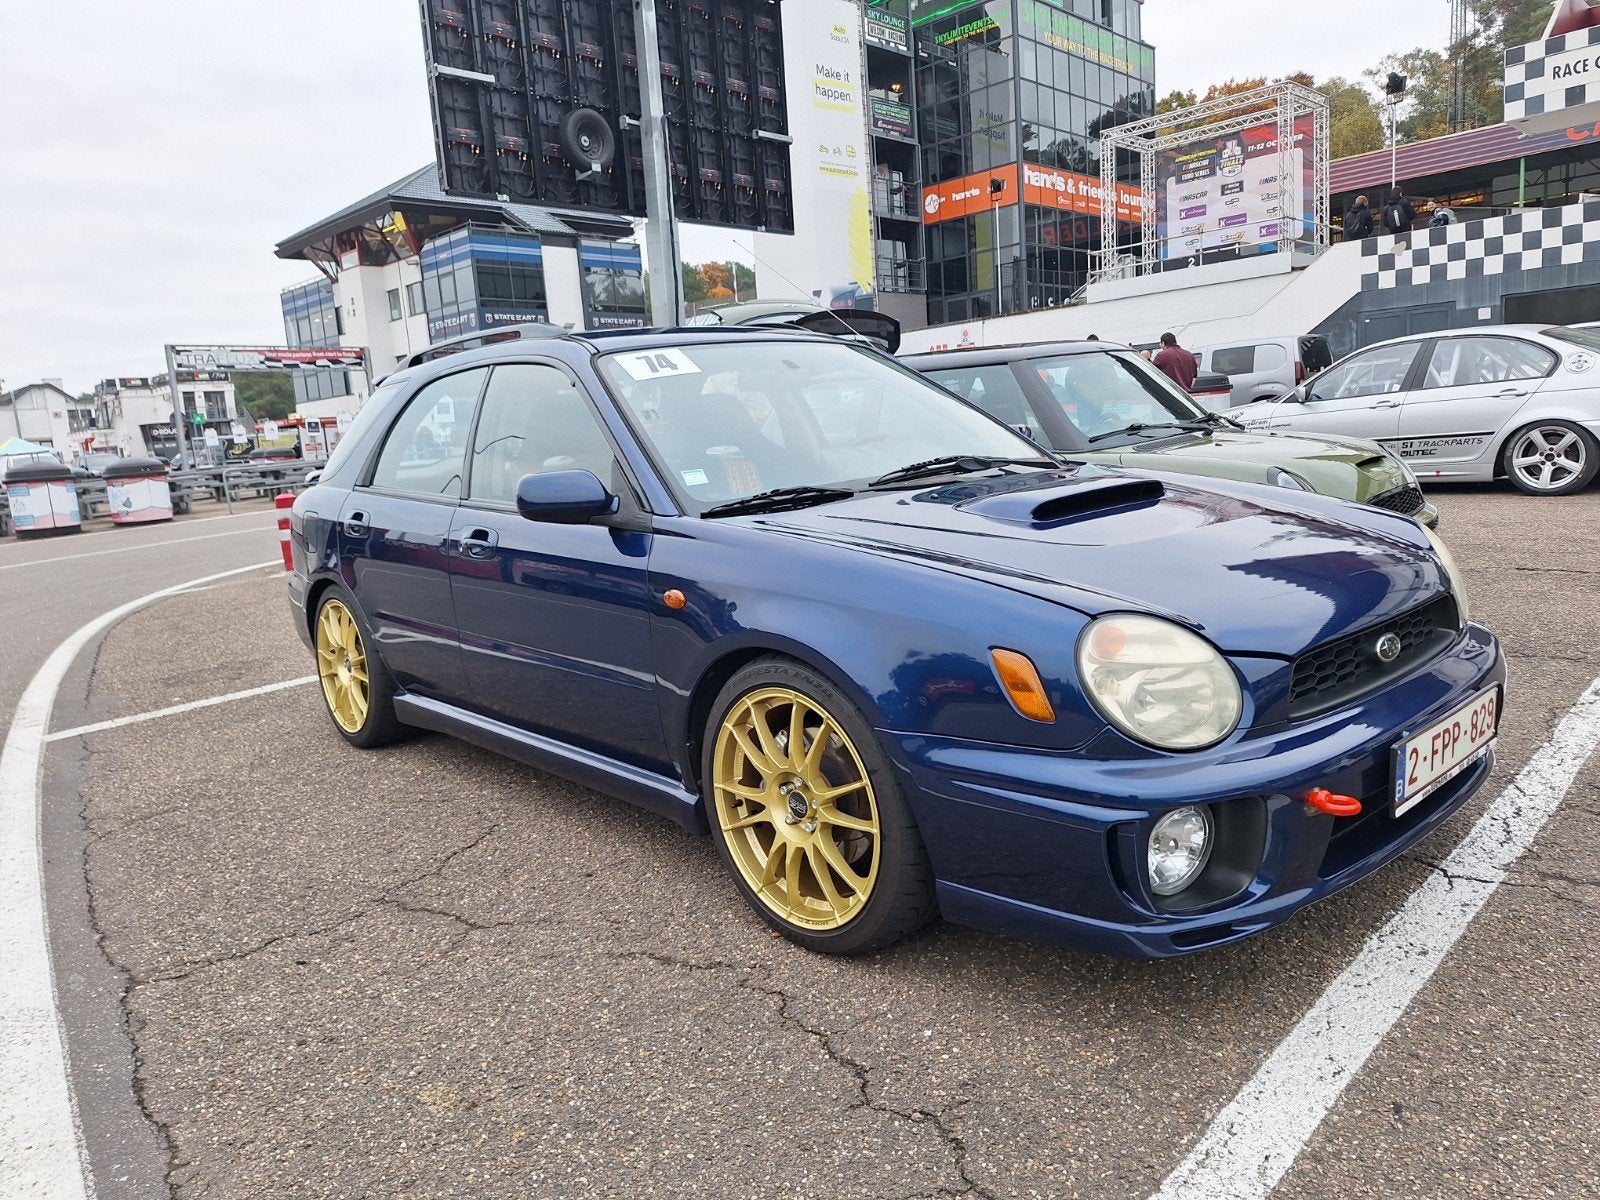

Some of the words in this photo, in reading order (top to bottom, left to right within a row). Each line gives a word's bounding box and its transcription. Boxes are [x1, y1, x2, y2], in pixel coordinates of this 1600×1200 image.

[867, 10, 880, 20] SKY
[881, 14, 905, 28] LOUNGE
[1044, 32, 1062, 47] YOUR
[1062, 40, 1076, 53] WAY
[1078, 44, 1086, 55] TO
[1087, 47, 1098, 60] THE
[816, 64, 841, 81] Make
[843, 70, 850, 83] it
[1552, 58, 1589, 80] RACE
[815, 83, 853, 102] happen.
[1247, 143, 1265, 153] 11-12
[1066, 178, 1076, 194] &
[1181, 173, 1194, 181] EURO
[1180, 190, 1208, 202] NASCAR
[1187, 257, 1195, 268] 2
[636, 353, 680, 373] 74
[1402, 441, 1414, 449] ST
[1418, 437, 1484, 448] TRACKPARTS
[1407, 697, 1495, 787] 2-FPP-829
[1396, 780, 1403, 800] B
